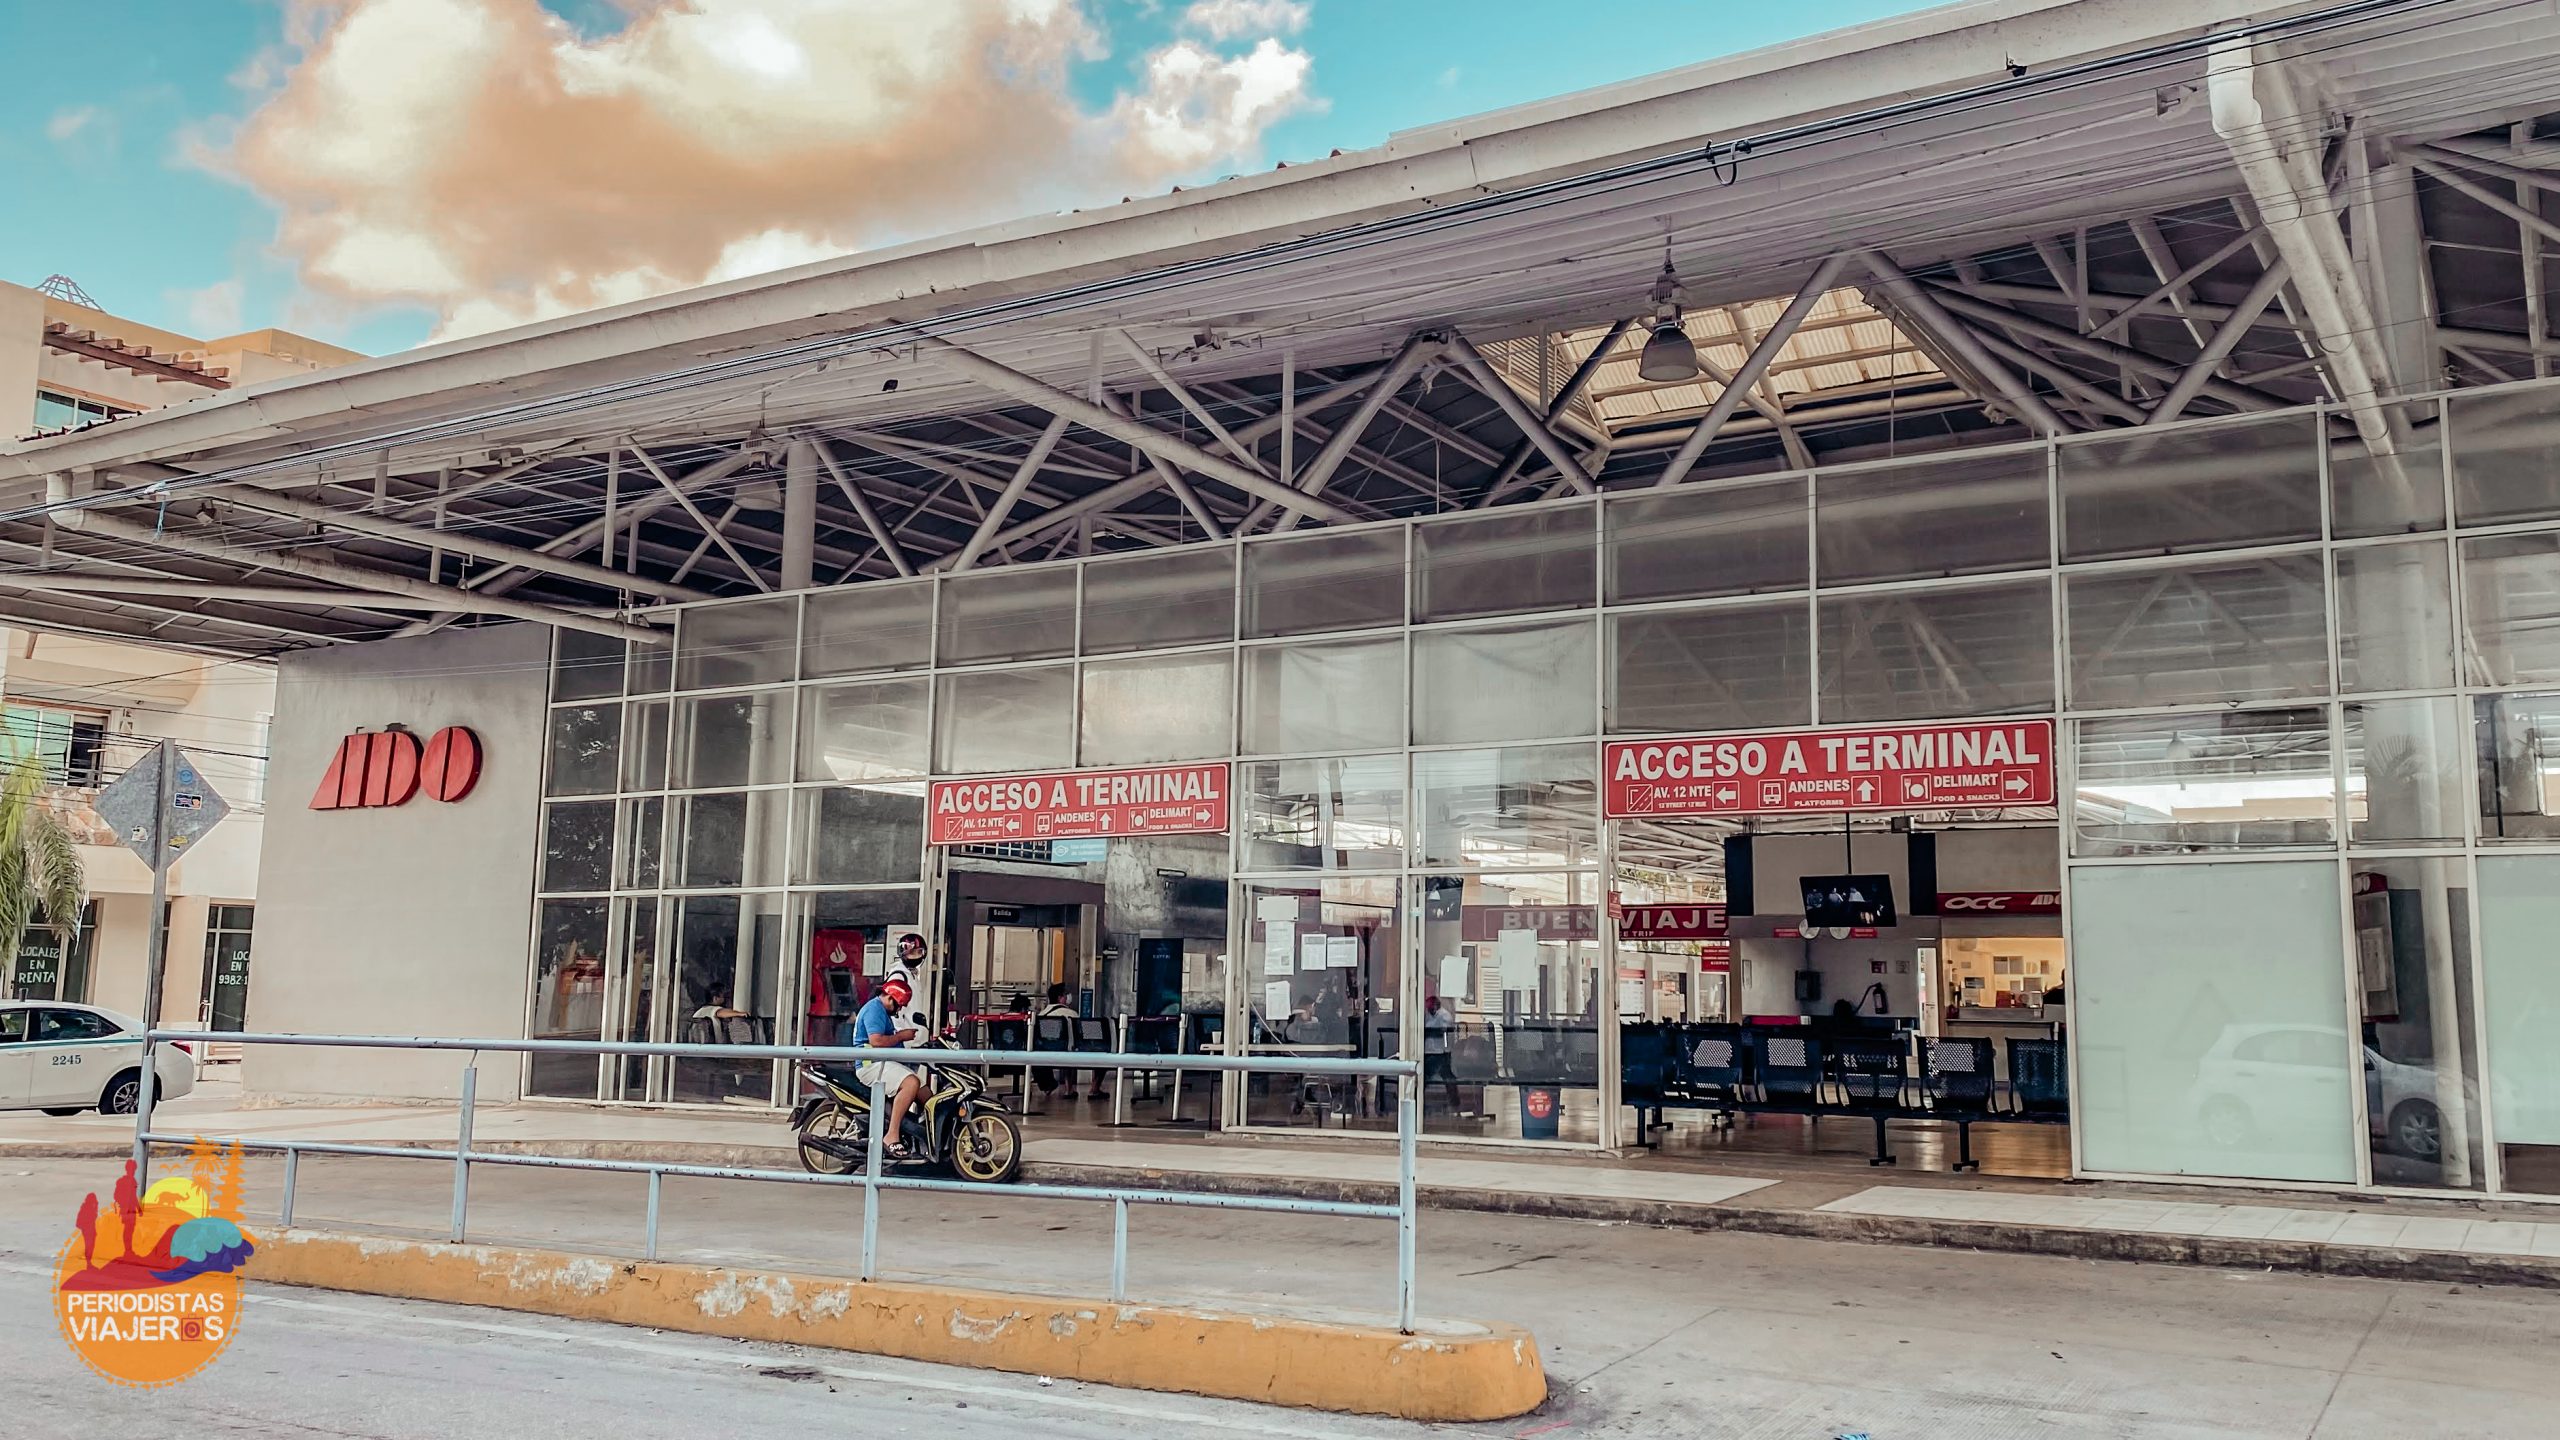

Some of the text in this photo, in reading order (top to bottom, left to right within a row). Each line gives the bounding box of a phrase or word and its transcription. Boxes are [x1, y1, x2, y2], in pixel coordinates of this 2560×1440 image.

[1614, 728, 2040, 781] ACCESO A TERMINAL
[308, 723, 483, 811] ADO
[1788, 779, 1851, 794] ANDENES
[1933, 773, 1999, 788] DELIMART
[937, 770, 1220, 815] ACCESO A TERMINAL
[1653, 785, 1712, 799] AV. 12 NTE
[1794, 799, 1845, 807] PLATFORMS
[1054, 811, 1096, 824] ANDENES
[1150, 806, 1193, 819] DELIMART
[963, 817, 1003, 829] AV. 12 NTE
[1945, 897, 2012, 910] OCC
[1503, 910, 1727, 929] BUEN VIAJE
[29, 959, 46, 970] EN
[230, 961, 243, 972] EN
[18, 971, 56, 984] RENTA
[51, 1054, 82, 1066] 2245
